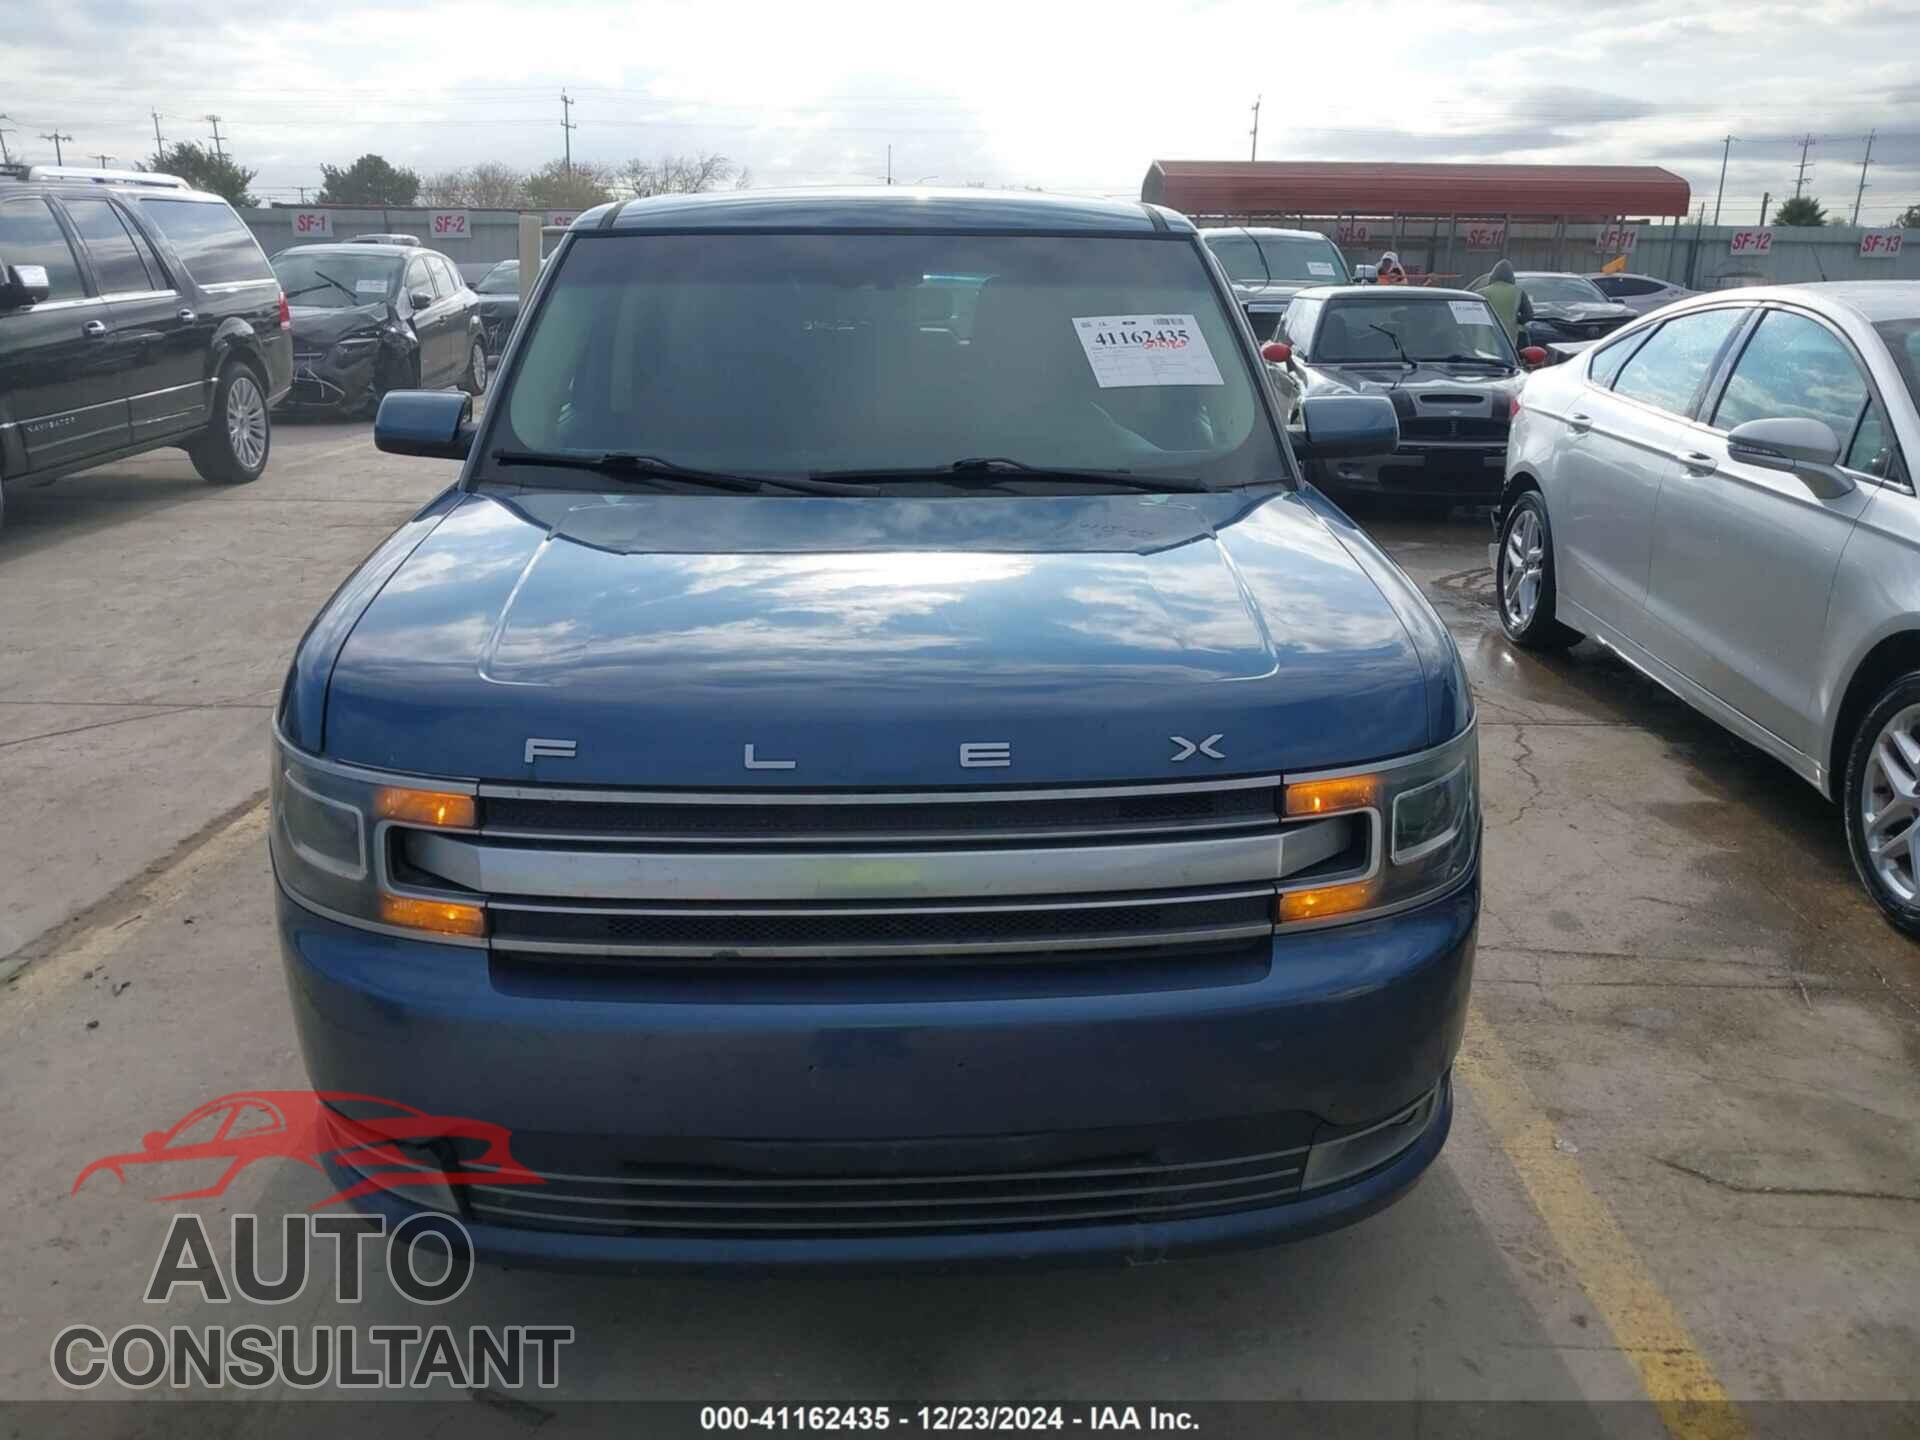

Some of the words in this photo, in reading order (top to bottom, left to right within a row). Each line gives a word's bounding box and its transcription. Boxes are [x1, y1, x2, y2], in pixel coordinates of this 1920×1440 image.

[297, 214, 326, 232] SF-1
[434, 215, 465, 233] SF-2
[1732, 232, 1772, 250] SF-12
[1862, 234, 1902, 252] SF-13
[1095, 329, 1190, 345] 41162435
